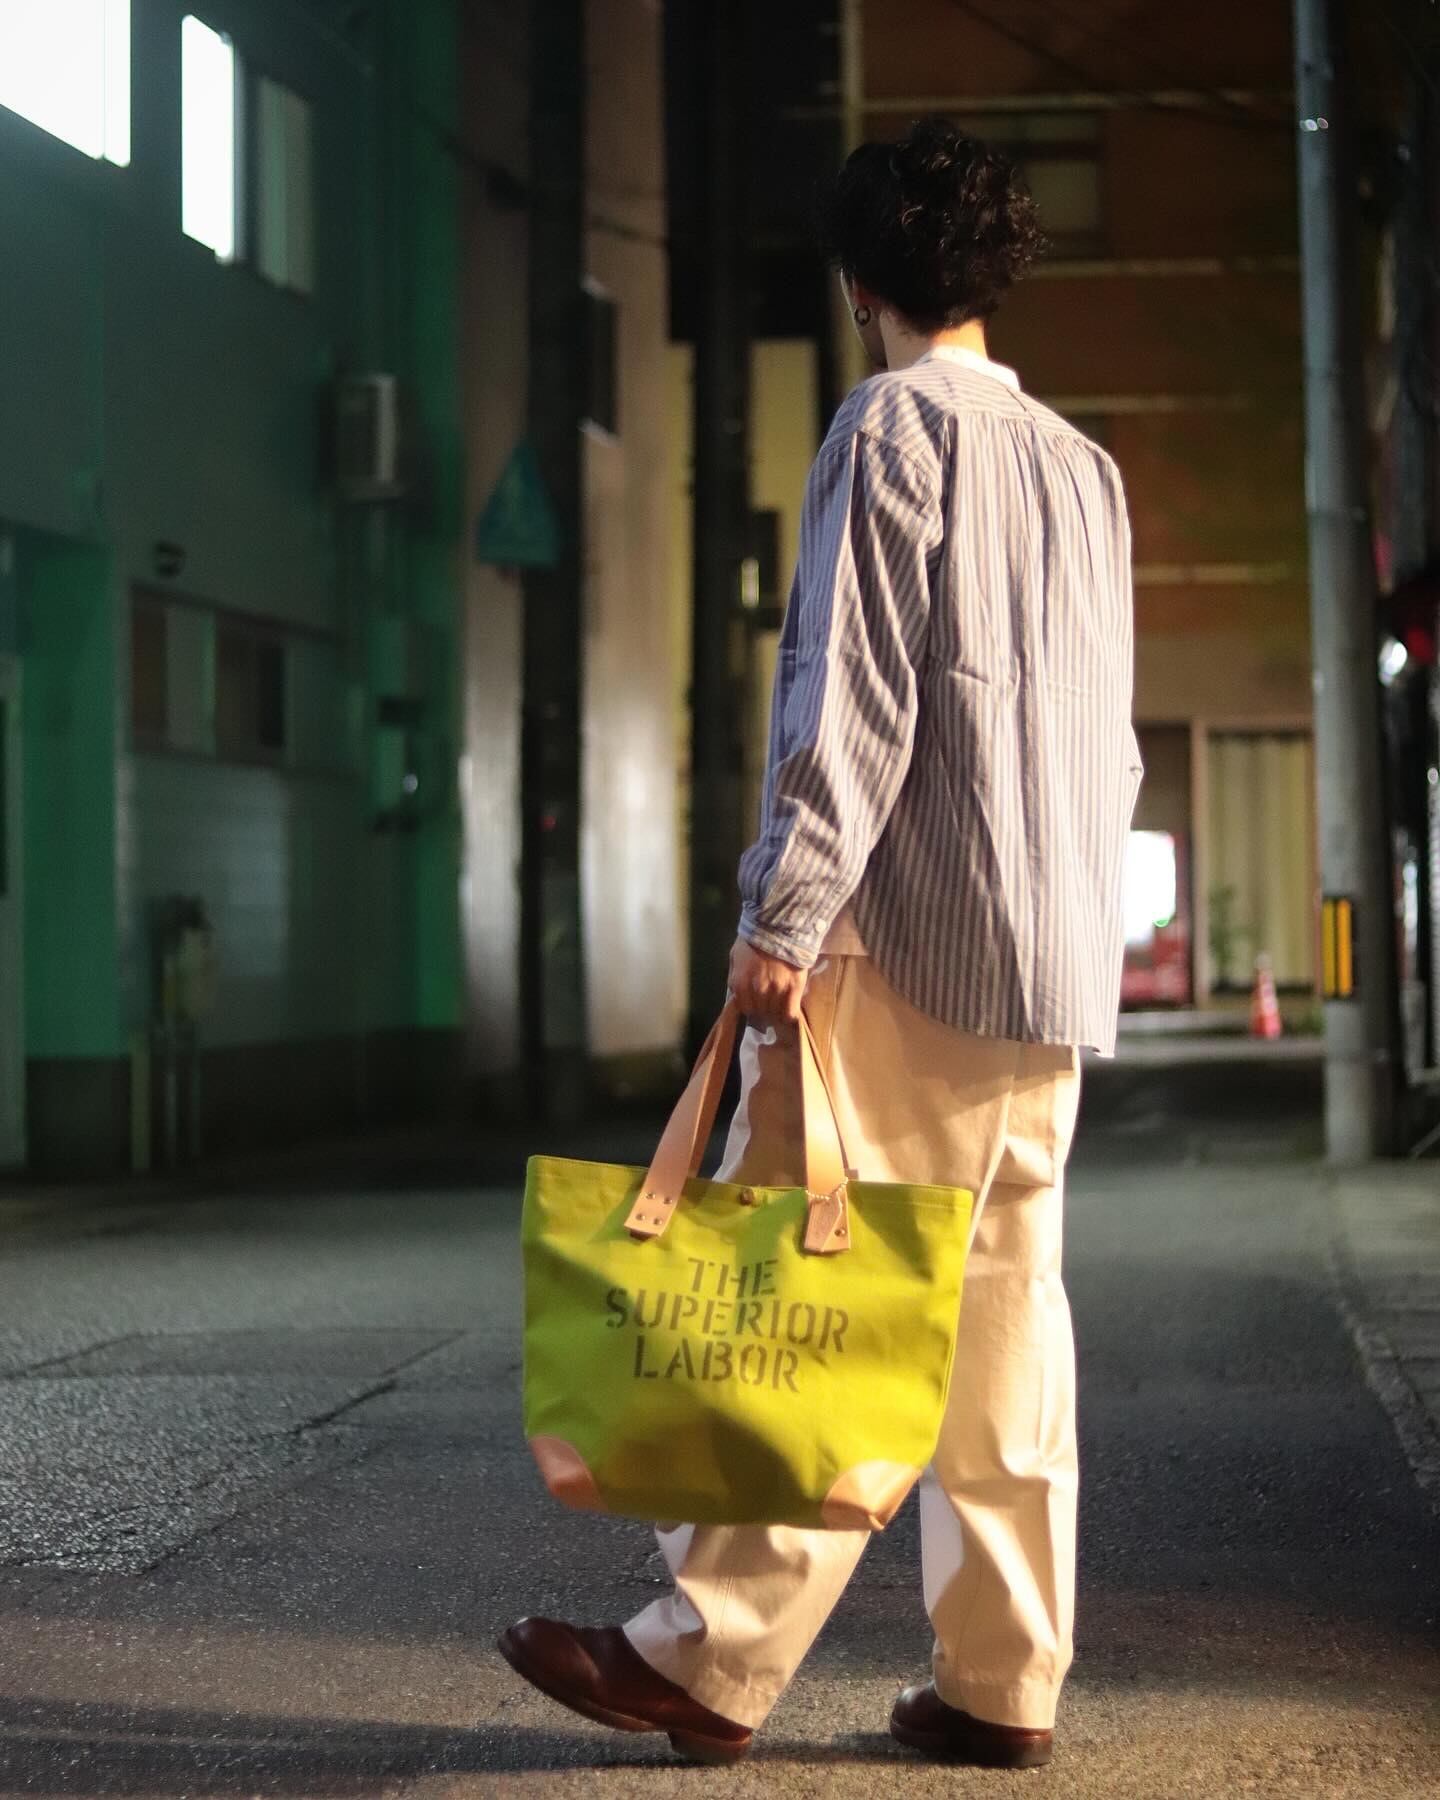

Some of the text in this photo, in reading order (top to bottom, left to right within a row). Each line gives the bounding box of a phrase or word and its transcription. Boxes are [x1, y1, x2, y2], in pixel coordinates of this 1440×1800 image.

[687, 1257, 779, 1298] THE
[605, 1288, 849, 1353] SUPERIOR
[633, 1335, 800, 1393] LABOR
